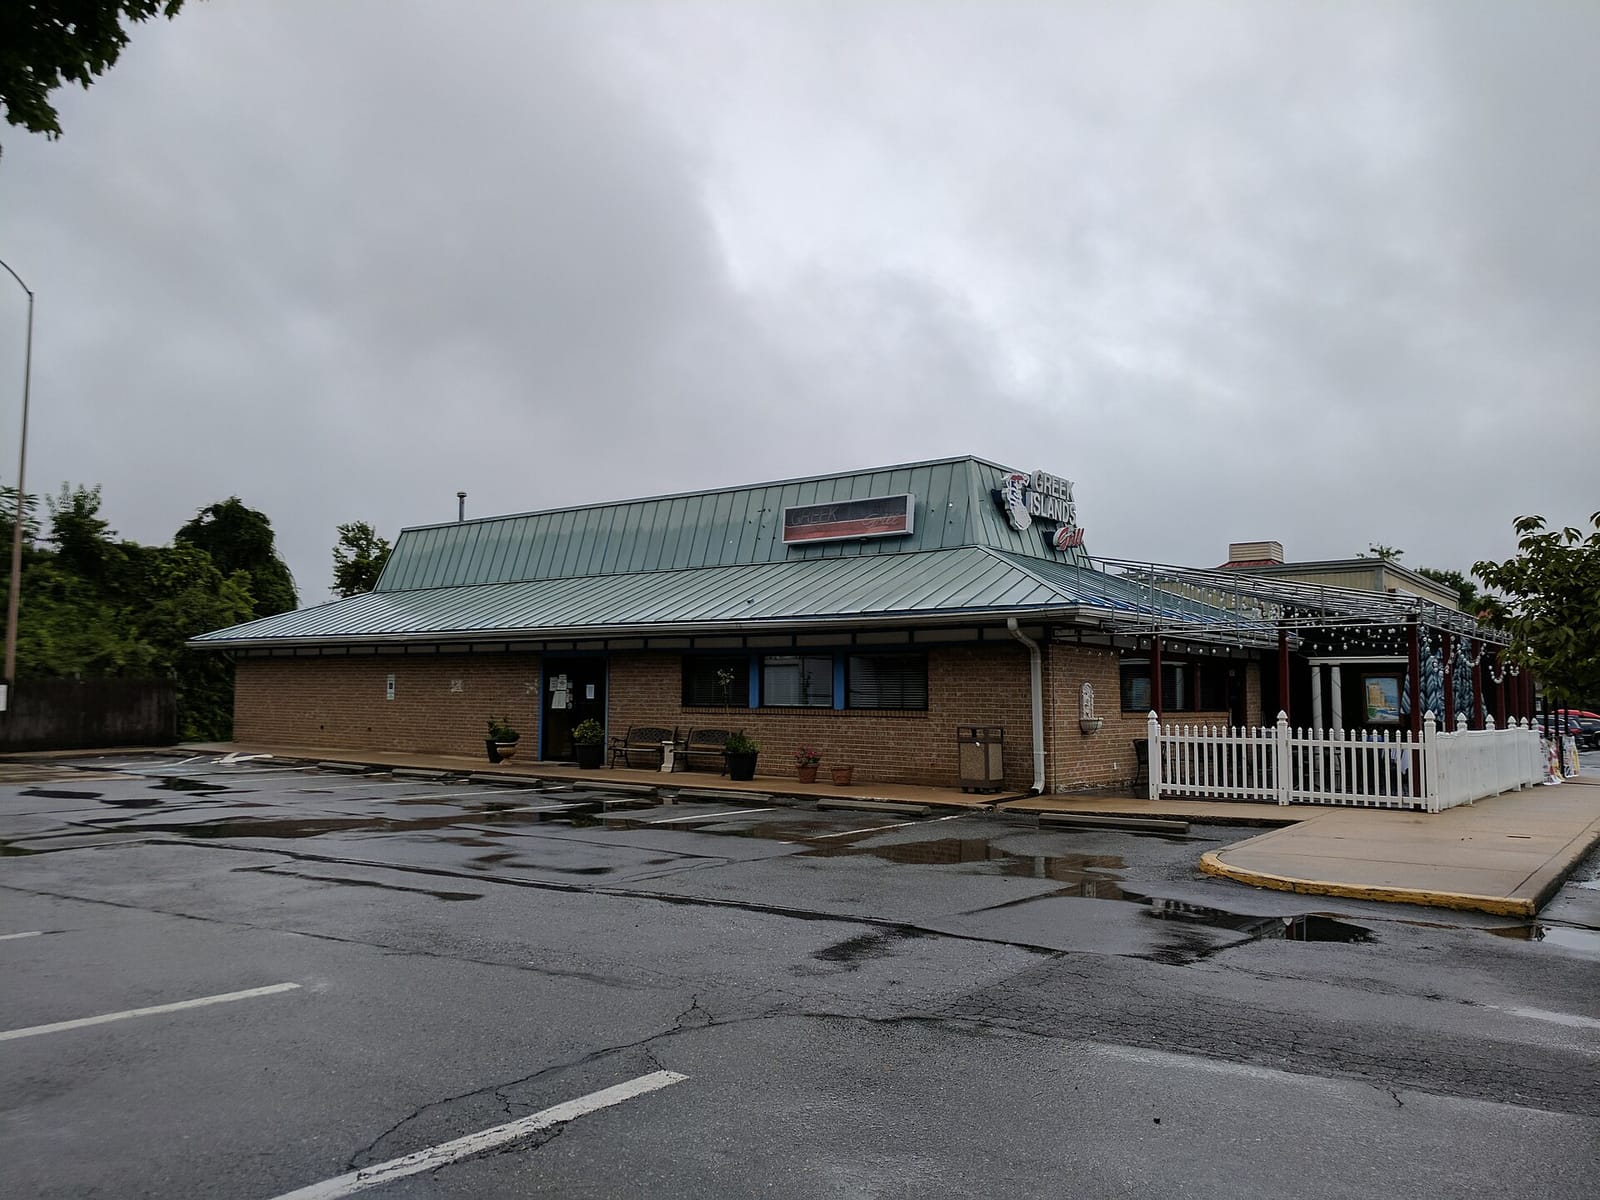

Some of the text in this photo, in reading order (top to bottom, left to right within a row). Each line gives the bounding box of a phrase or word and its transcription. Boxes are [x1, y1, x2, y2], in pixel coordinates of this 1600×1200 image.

[1032, 470, 1074, 502] GREEK
[791, 506, 839, 525] GREEK
[1028, 492, 1077, 525] ISLANDS
[1055, 527, 1084, 551] Grill
